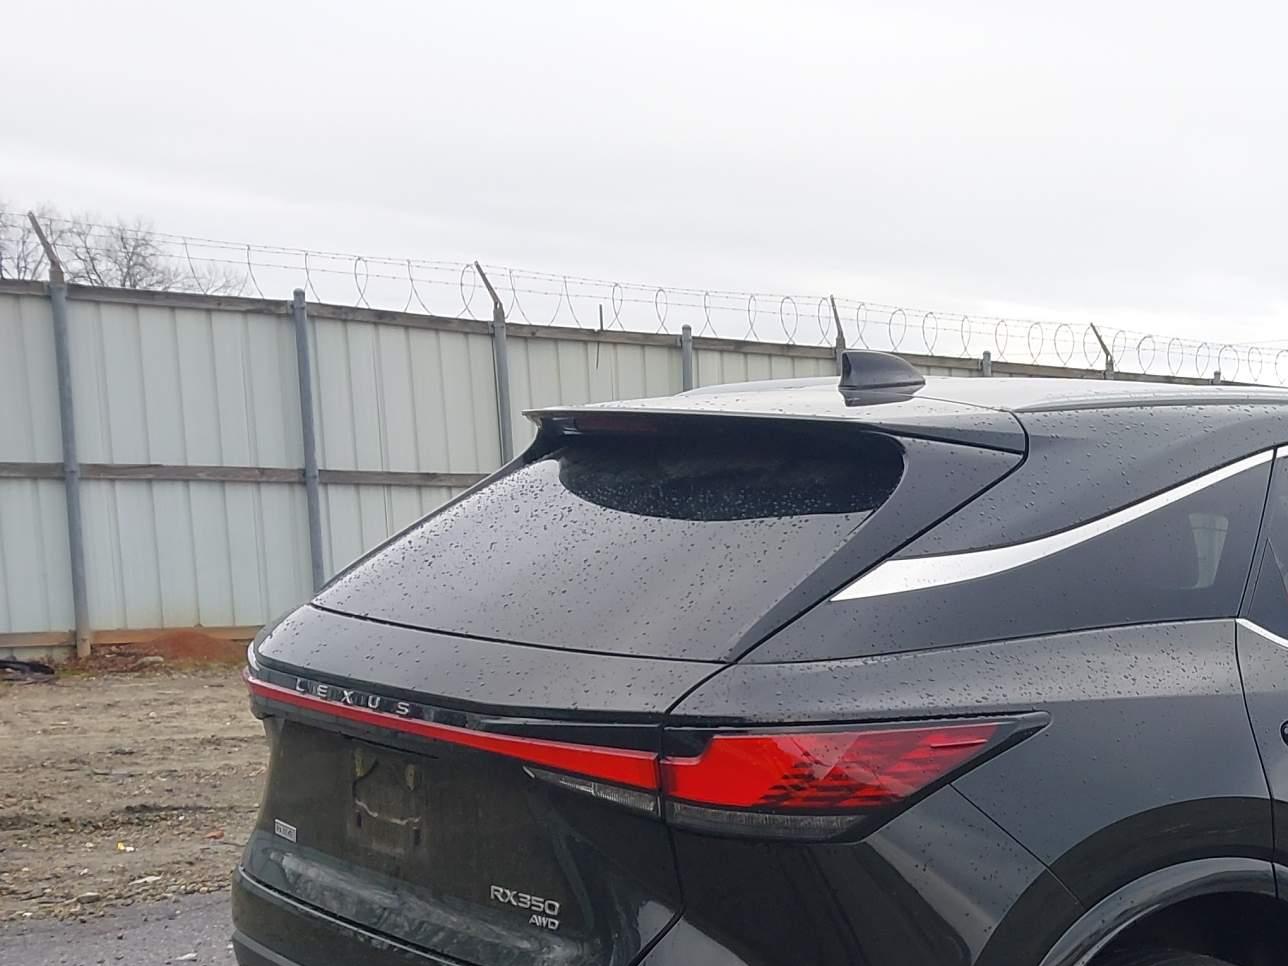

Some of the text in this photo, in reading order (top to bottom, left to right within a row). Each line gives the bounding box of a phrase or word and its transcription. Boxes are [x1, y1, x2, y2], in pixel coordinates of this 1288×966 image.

[295, 678, 410, 715] LEXUS
[490, 885, 560, 915] RX350
[528, 914, 560, 930] AWD
